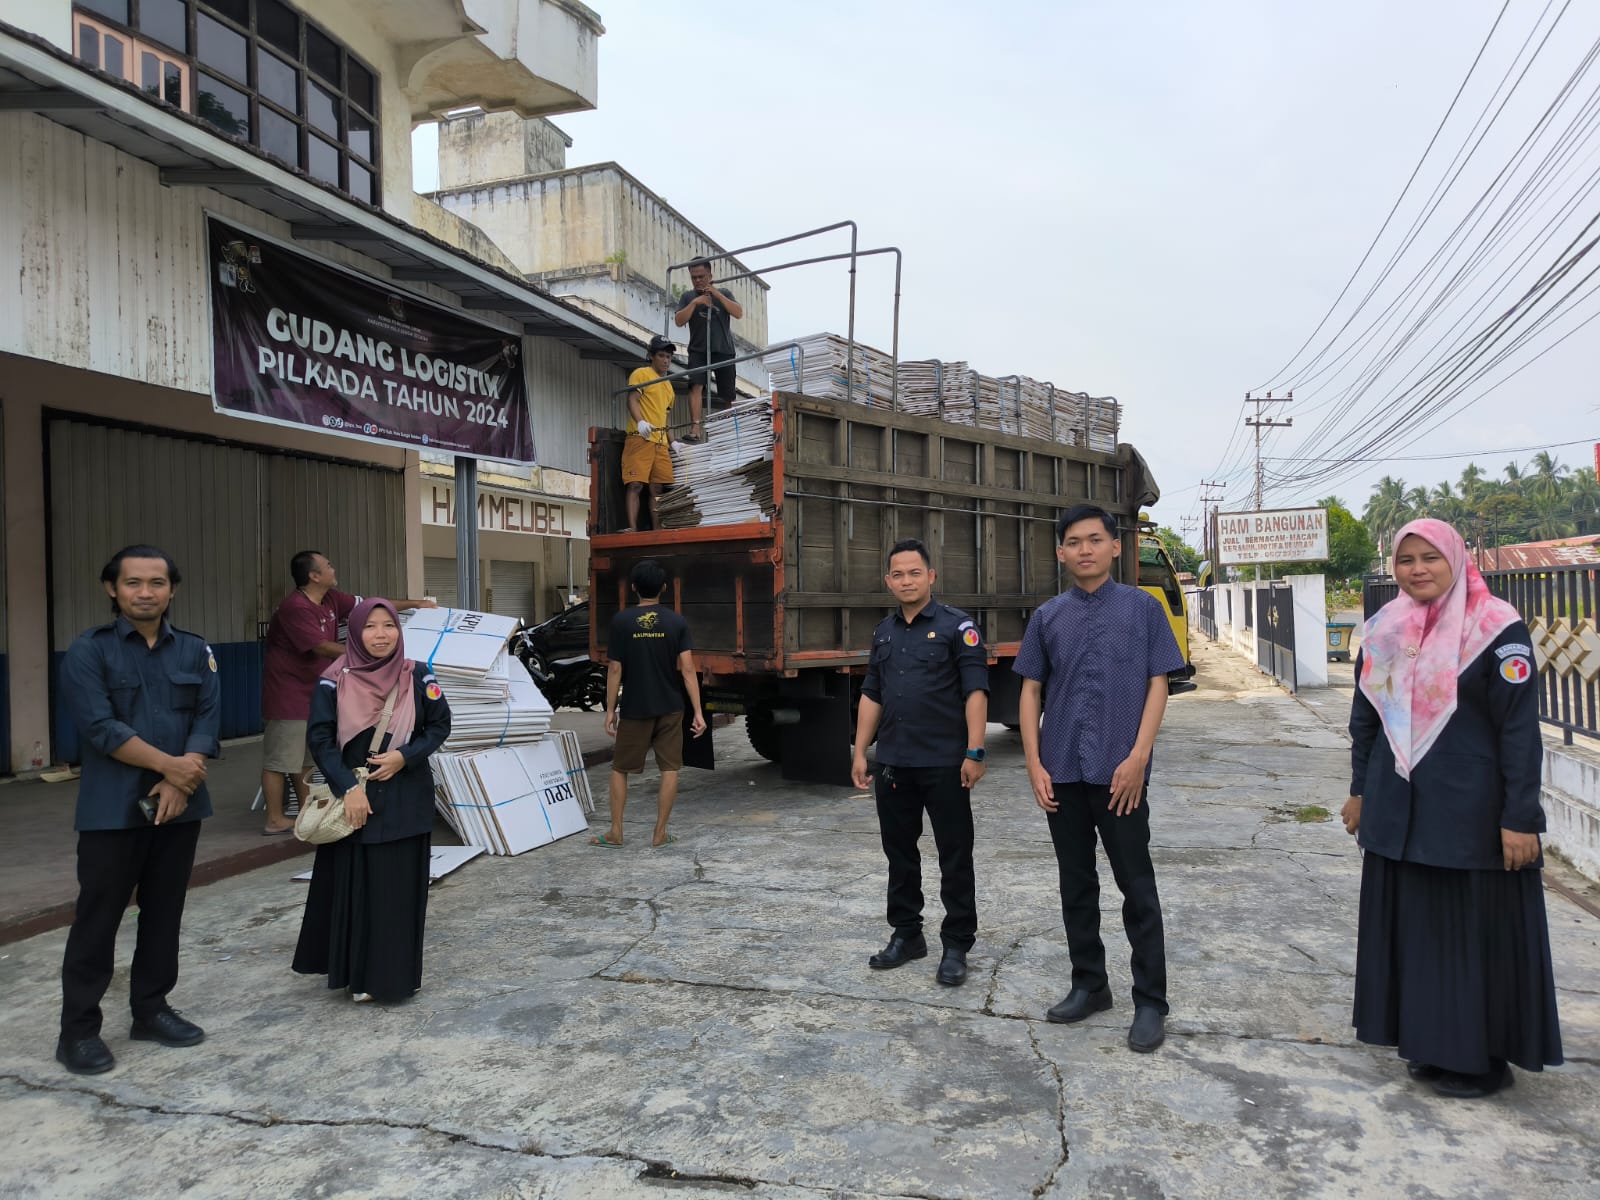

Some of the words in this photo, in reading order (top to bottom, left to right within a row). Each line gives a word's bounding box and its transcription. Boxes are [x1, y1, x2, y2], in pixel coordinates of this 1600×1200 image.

[266, 307, 394, 371] GUDANG
[400, 347, 500, 399] LOGISTIK
[258, 345, 379, 402] PILKADA
[382, 379, 461, 420] TAHUN
[463, 400, 508, 429] 2024
[489, 494, 571, 536] MEUBEL
[1221, 518, 1249, 535] HAM
[1255, 514, 1323, 533] BANGUNAN
[1223, 536, 1240, 545] JUAL
[457, 613, 483, 632] KPU
[544, 782, 574, 805] KPU
